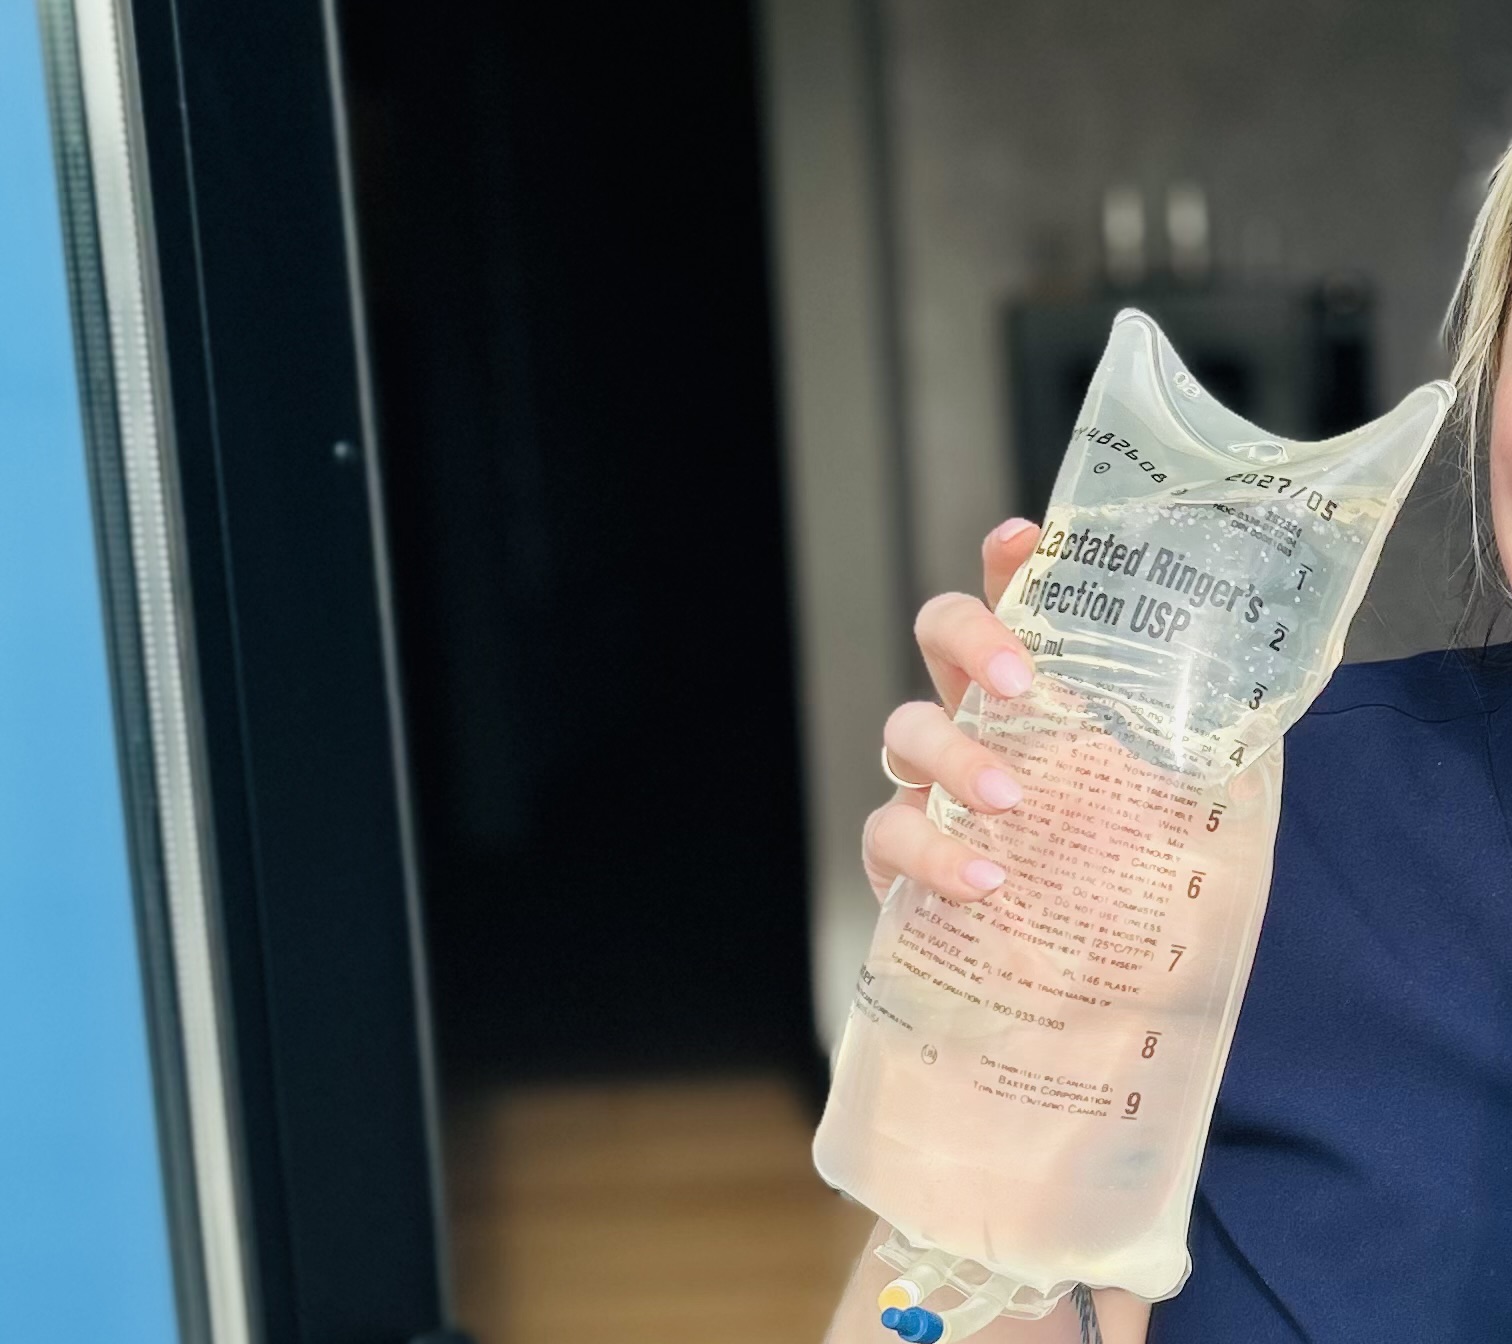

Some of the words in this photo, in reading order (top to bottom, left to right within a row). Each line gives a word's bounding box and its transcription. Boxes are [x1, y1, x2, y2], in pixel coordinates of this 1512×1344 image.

[1223, 469, 1339, 522] 2027/05
[1036, 520, 1150, 577] Lactated
[1148, 546, 1264, 624] Ringer's
[1018, 567, 1125, 627] Injection
[1129, 593, 1191, 643] USP
[1041, 637, 1067, 657] mL
[1267, 628, 1287, 652] 2
[1246, 688, 1265, 711] 3
[1228, 745, 1245, 768] 4
[1204, 808, 1223, 833] 5
[1186, 874, 1203, 899] 6
[1167, 948, 1184, 972] 7
[1140, 1035, 1158, 1059] 8
[1123, 1091, 1141, 1115] 9
